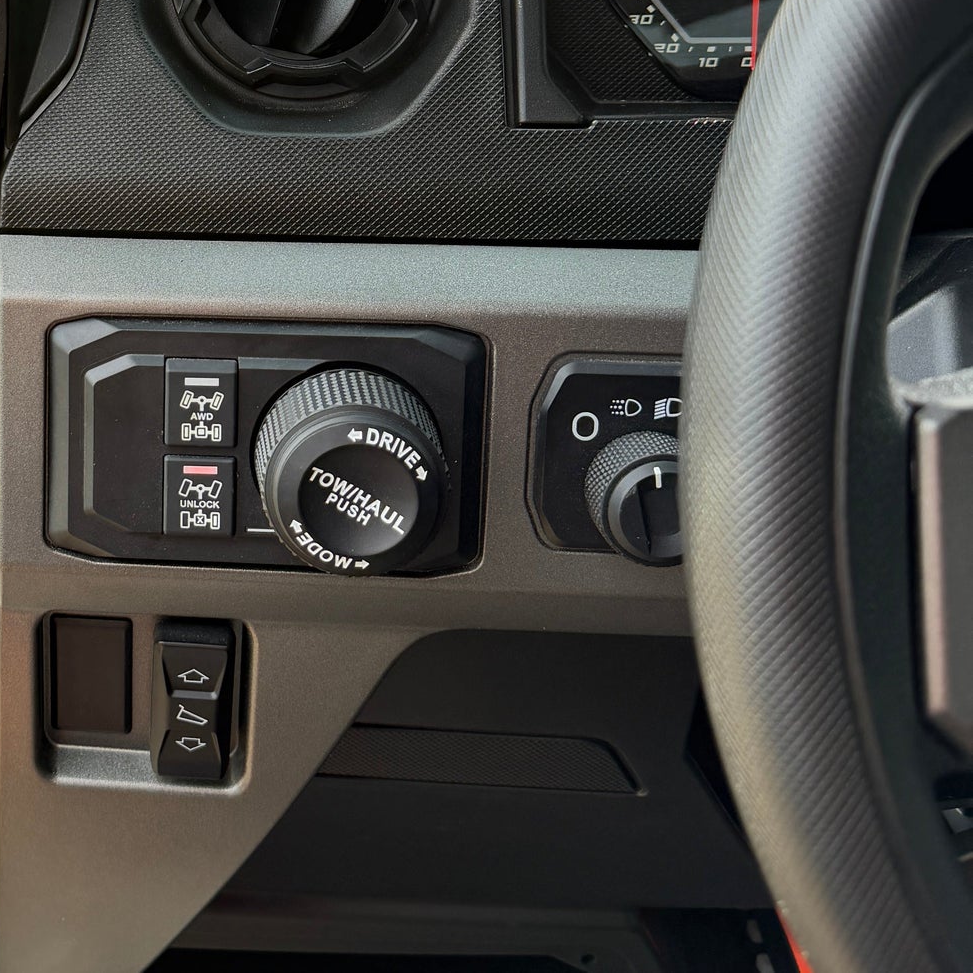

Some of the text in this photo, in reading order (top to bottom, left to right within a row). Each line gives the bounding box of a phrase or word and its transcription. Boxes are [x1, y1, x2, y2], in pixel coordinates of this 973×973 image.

[629, 14, 654, 25] 30
[653, 43, 680, 53] 20
[698, 57, 719, 68] 10
[190, 412, 214, 422] AWD
[365, 427, 422, 469] DRIVE
[179, 499, 220, 510] UNLOCK
[308, 466, 406, 535] TOW/HAUL
[326, 493, 372, 527] PUSH
[295, 531, 353, 570] MODE
